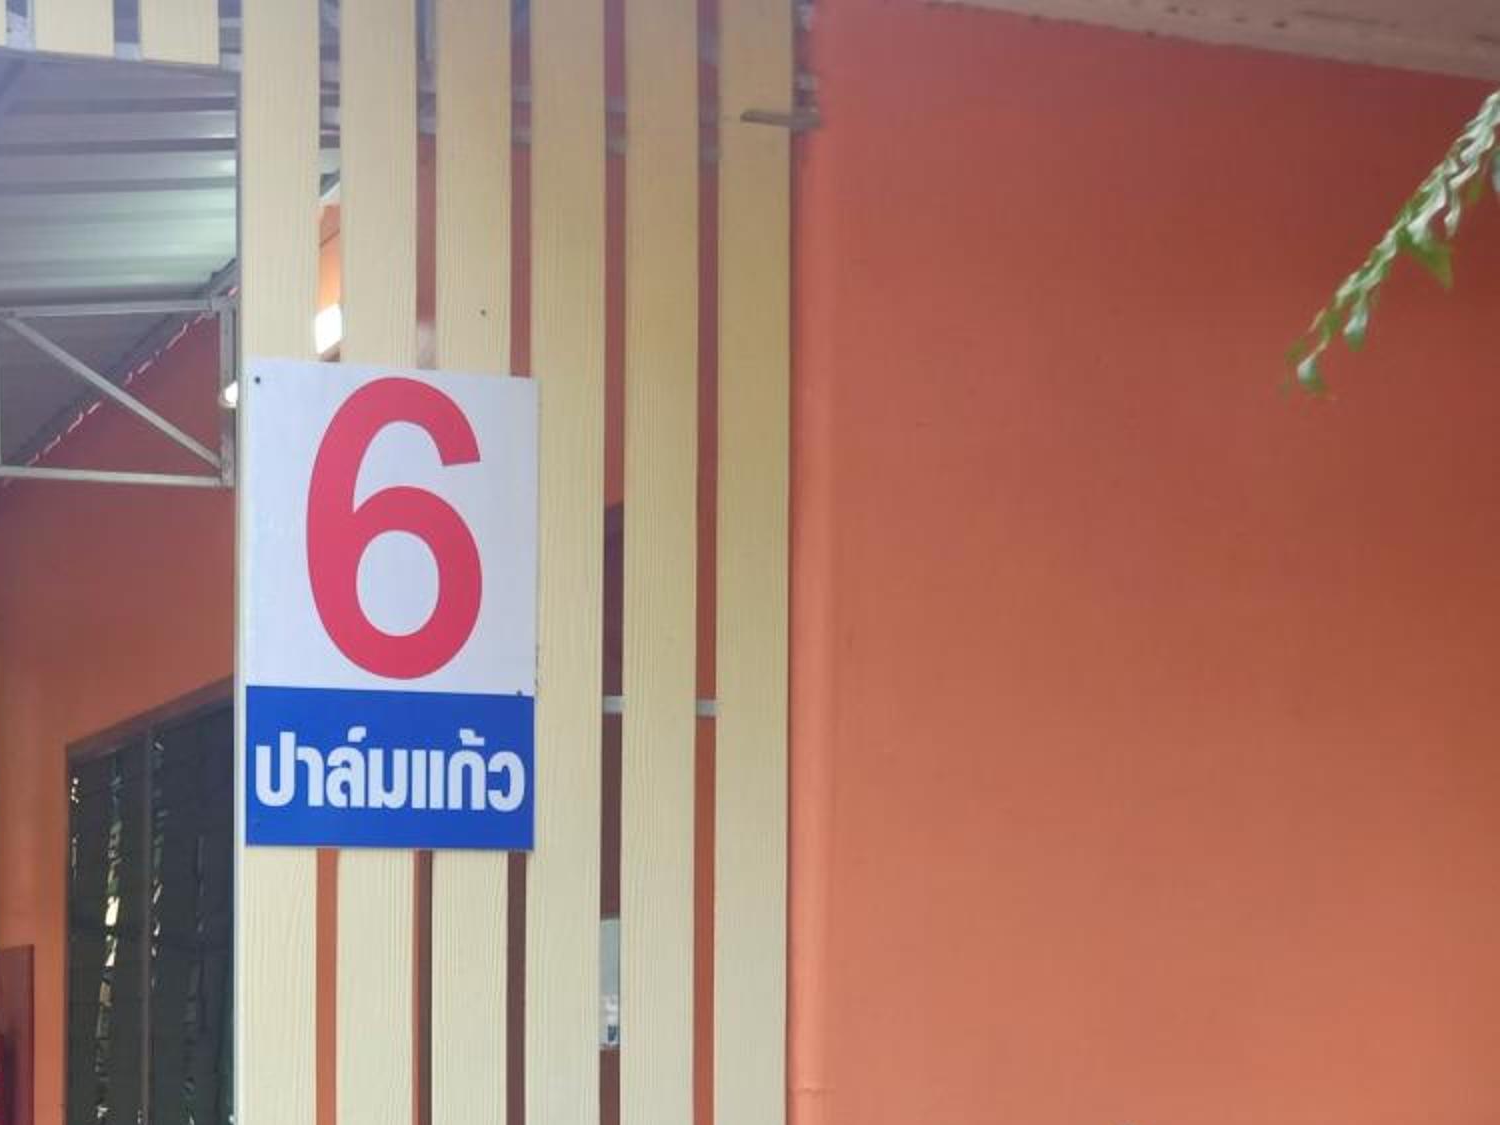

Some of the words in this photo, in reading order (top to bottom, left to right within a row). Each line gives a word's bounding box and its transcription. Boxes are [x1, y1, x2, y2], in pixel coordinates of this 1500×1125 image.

[306, 376, 483, 680] 6
[255, 726, 525, 812] ปาล์มแก้ว
